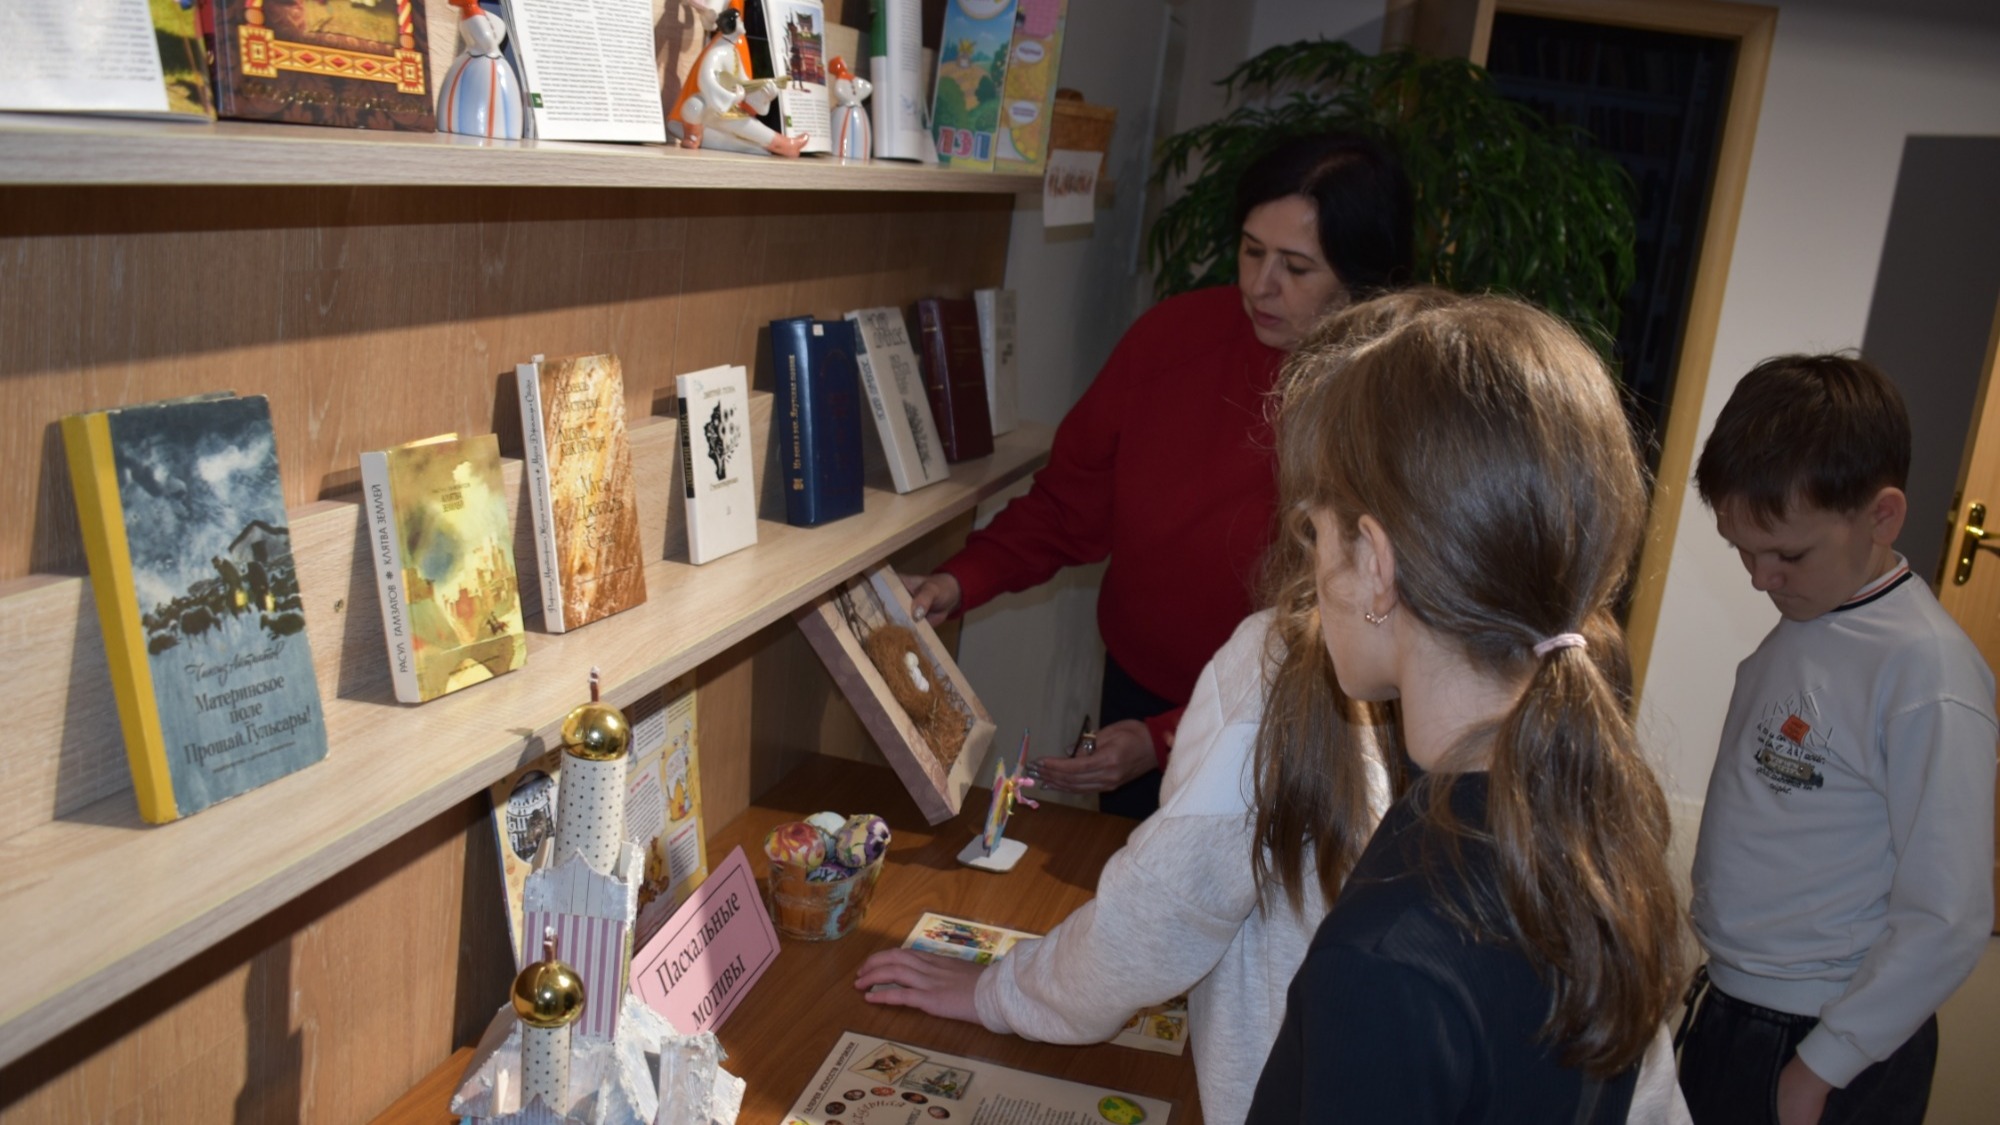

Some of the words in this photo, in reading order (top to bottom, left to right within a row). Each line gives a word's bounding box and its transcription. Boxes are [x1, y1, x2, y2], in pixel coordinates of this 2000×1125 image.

[371, 483, 387, 525] ЗЕМЛЕЙ
[379, 526, 392, 566] КЛЯТВА
[388, 585, 402, 636] ГАМЗАТОВ
[395, 642, 408, 672] РАСУЛ
[195, 675, 285, 714] Материнское
[229, 702, 263, 724] поле
[244, 704, 313, 746] Гульсары!
[655, 892, 741, 997] Пасхальные
[691, 953, 747, 1031] мотивы
